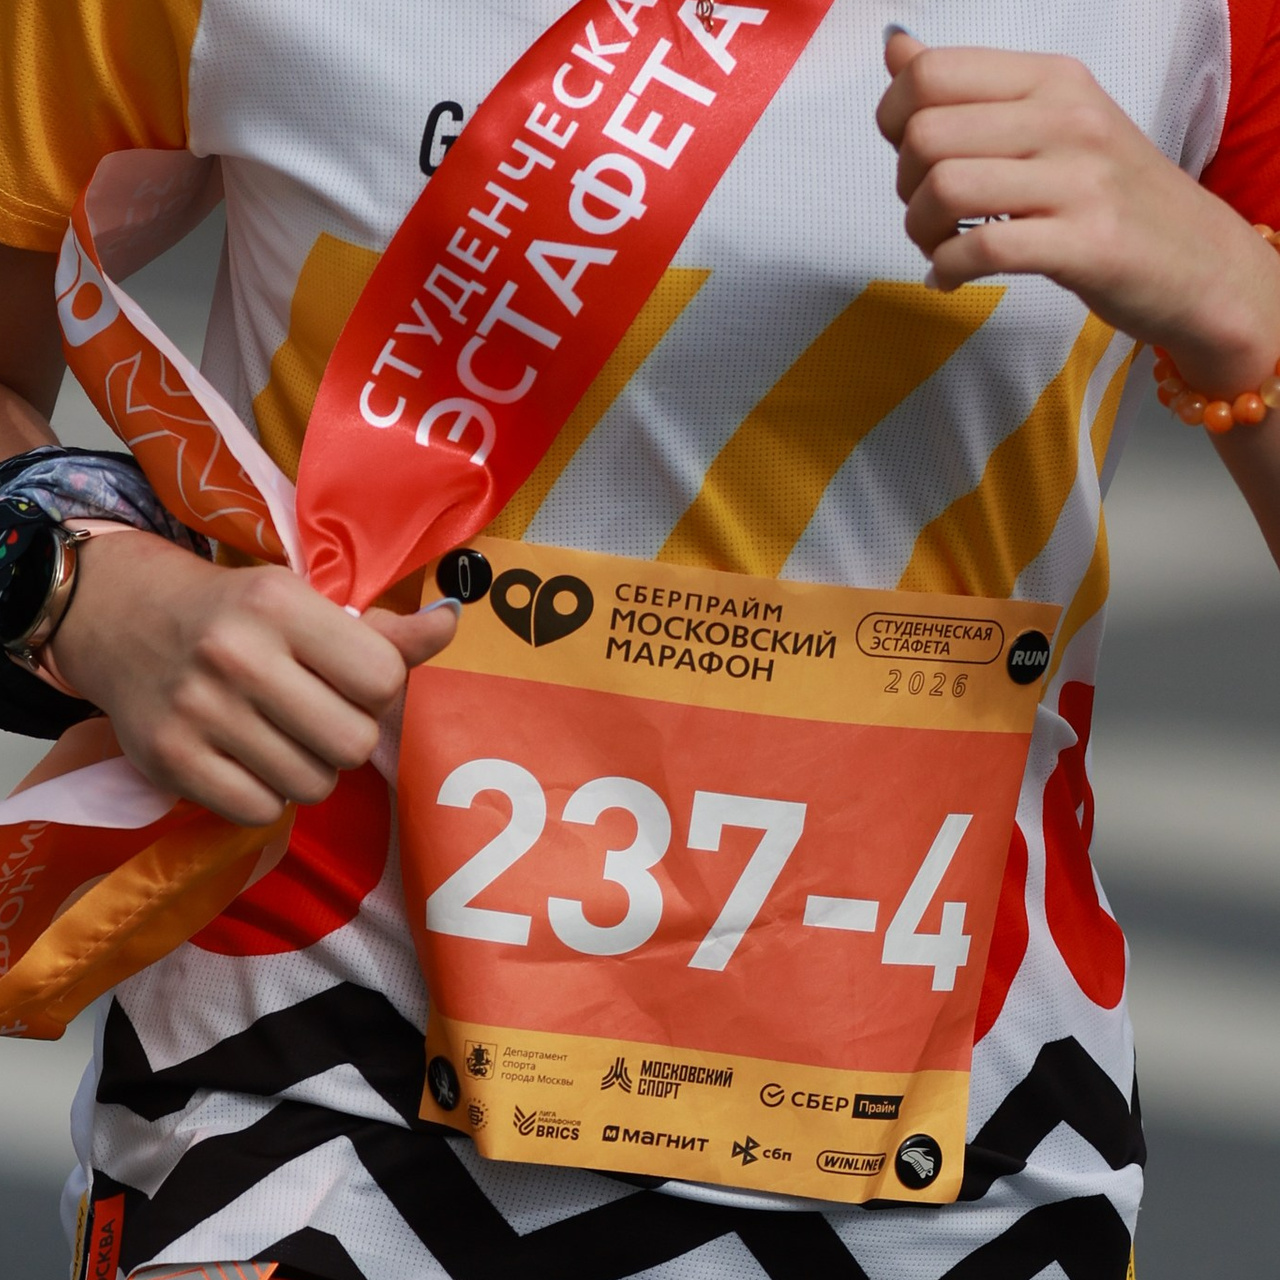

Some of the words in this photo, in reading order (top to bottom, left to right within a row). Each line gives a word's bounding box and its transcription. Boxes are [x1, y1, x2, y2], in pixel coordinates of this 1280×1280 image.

[615, 583, 783, 622] СБЕРПРАЙМ
[610, 607, 837, 659] МОСКОВСКИЙ
[873, 619, 993, 641] СТУДЕНЧЕСКАЯ
[870, 636, 950, 655] ЭСТАФЕТА
[606, 637, 775, 682] МАРАФОН
[1011, 650, 1048, 666] RUN
[884, 669, 968, 697] 2026
[425, 757, 974, 992] 237-4
[502, 1046, 568, 1062] Департамент
[501, 1059, 536, 1071] спорта
[639, 1059, 733, 1088] МОСКОВСКИЙ
[500, 1071, 535, 1084] города
[536, 1075, 574, 1087] Москвы
[637, 1080, 682, 1100] СПОРТ
[790, 1090, 850, 1113] СБЕР
[858, 1099, 896, 1115] Прайм
[536, 1124, 580, 1141] BRICS
[762, 1147, 792, 1162] сбп
[824, 1155, 880, 1171] WINLINE
